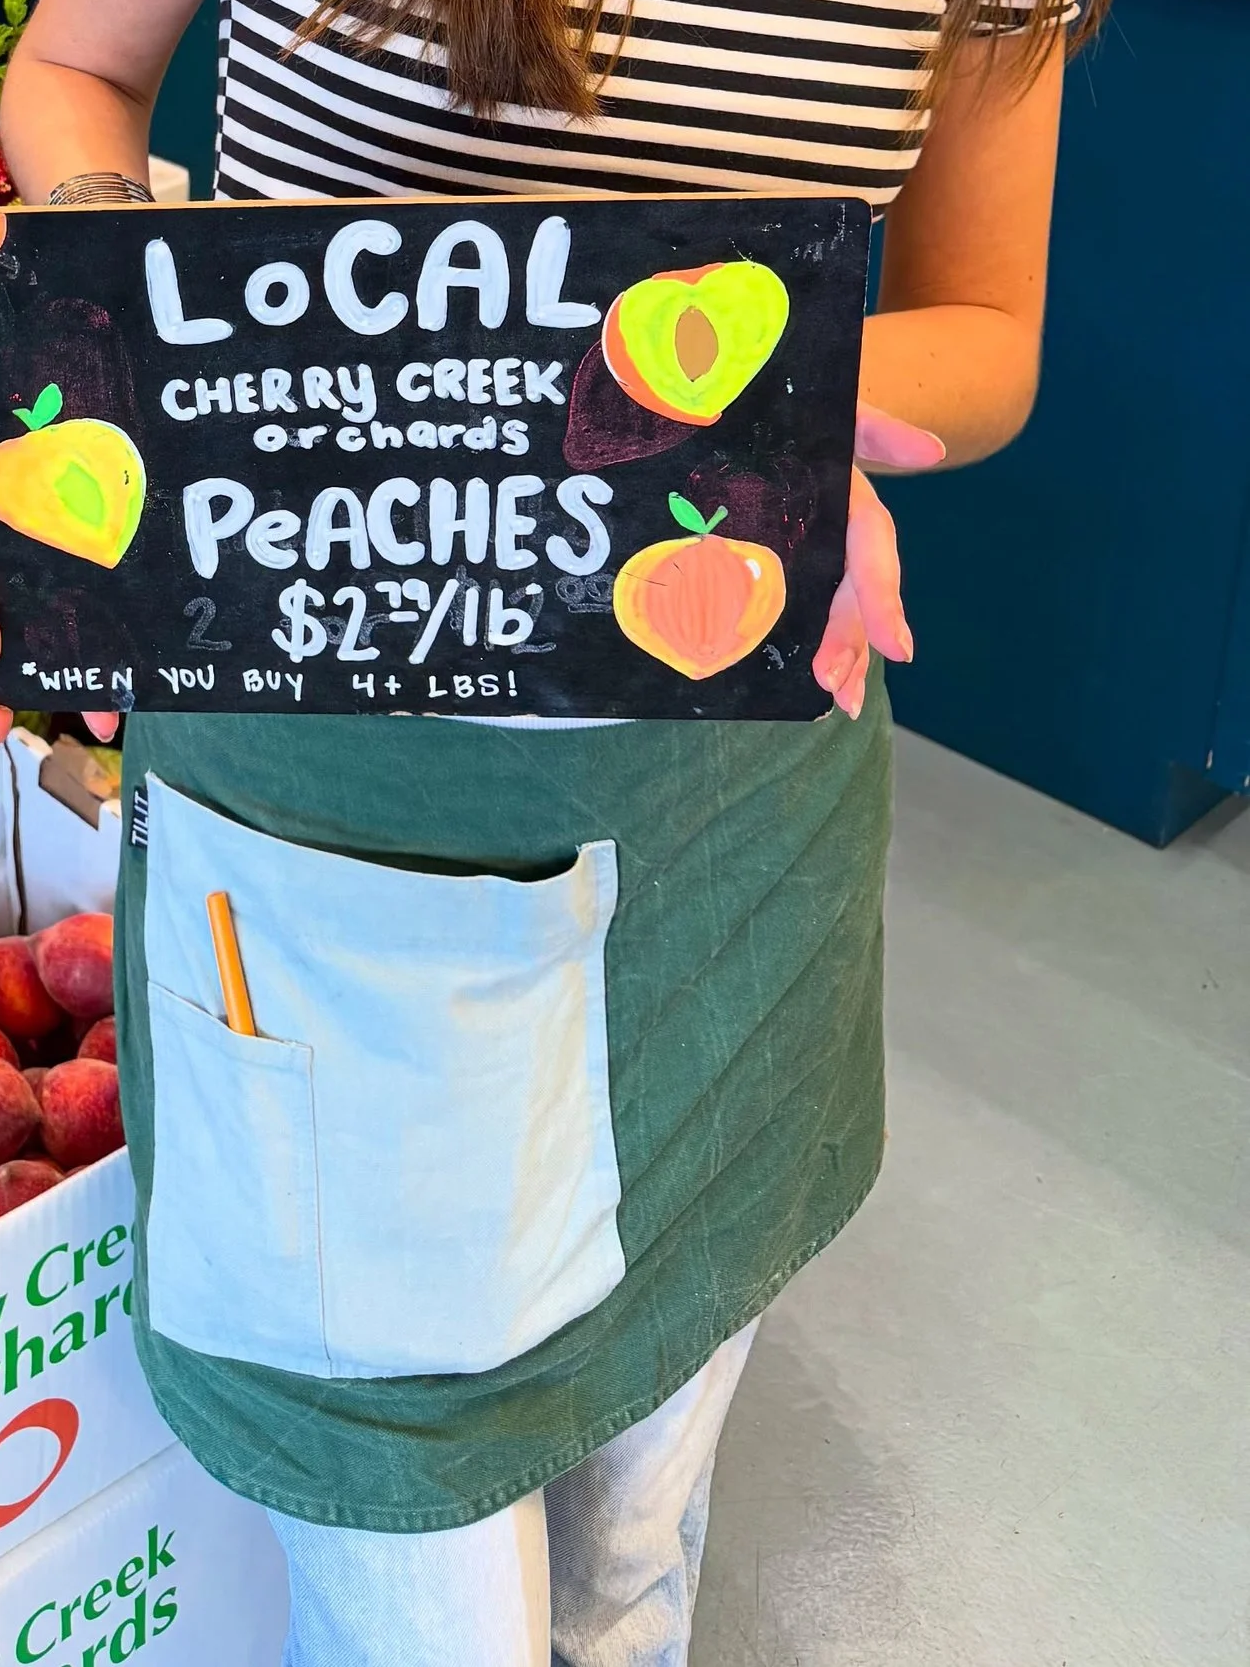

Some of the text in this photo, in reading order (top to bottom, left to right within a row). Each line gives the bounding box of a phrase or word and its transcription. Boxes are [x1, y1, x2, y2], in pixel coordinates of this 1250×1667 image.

[161, 358, 565, 423] CHERRY CREEK
[253, 416, 529, 455] orchards
[159, 664, 217, 696] YOU
[242, 668, 305, 702] BUY
[352, 673, 401, 698] 4+
[427, 670, 518, 700] LBS!
[131, 791, 148, 845] TILIT
[26, 1220, 136, 1307] Cre
[15, 1524, 176, 1665] Creek
